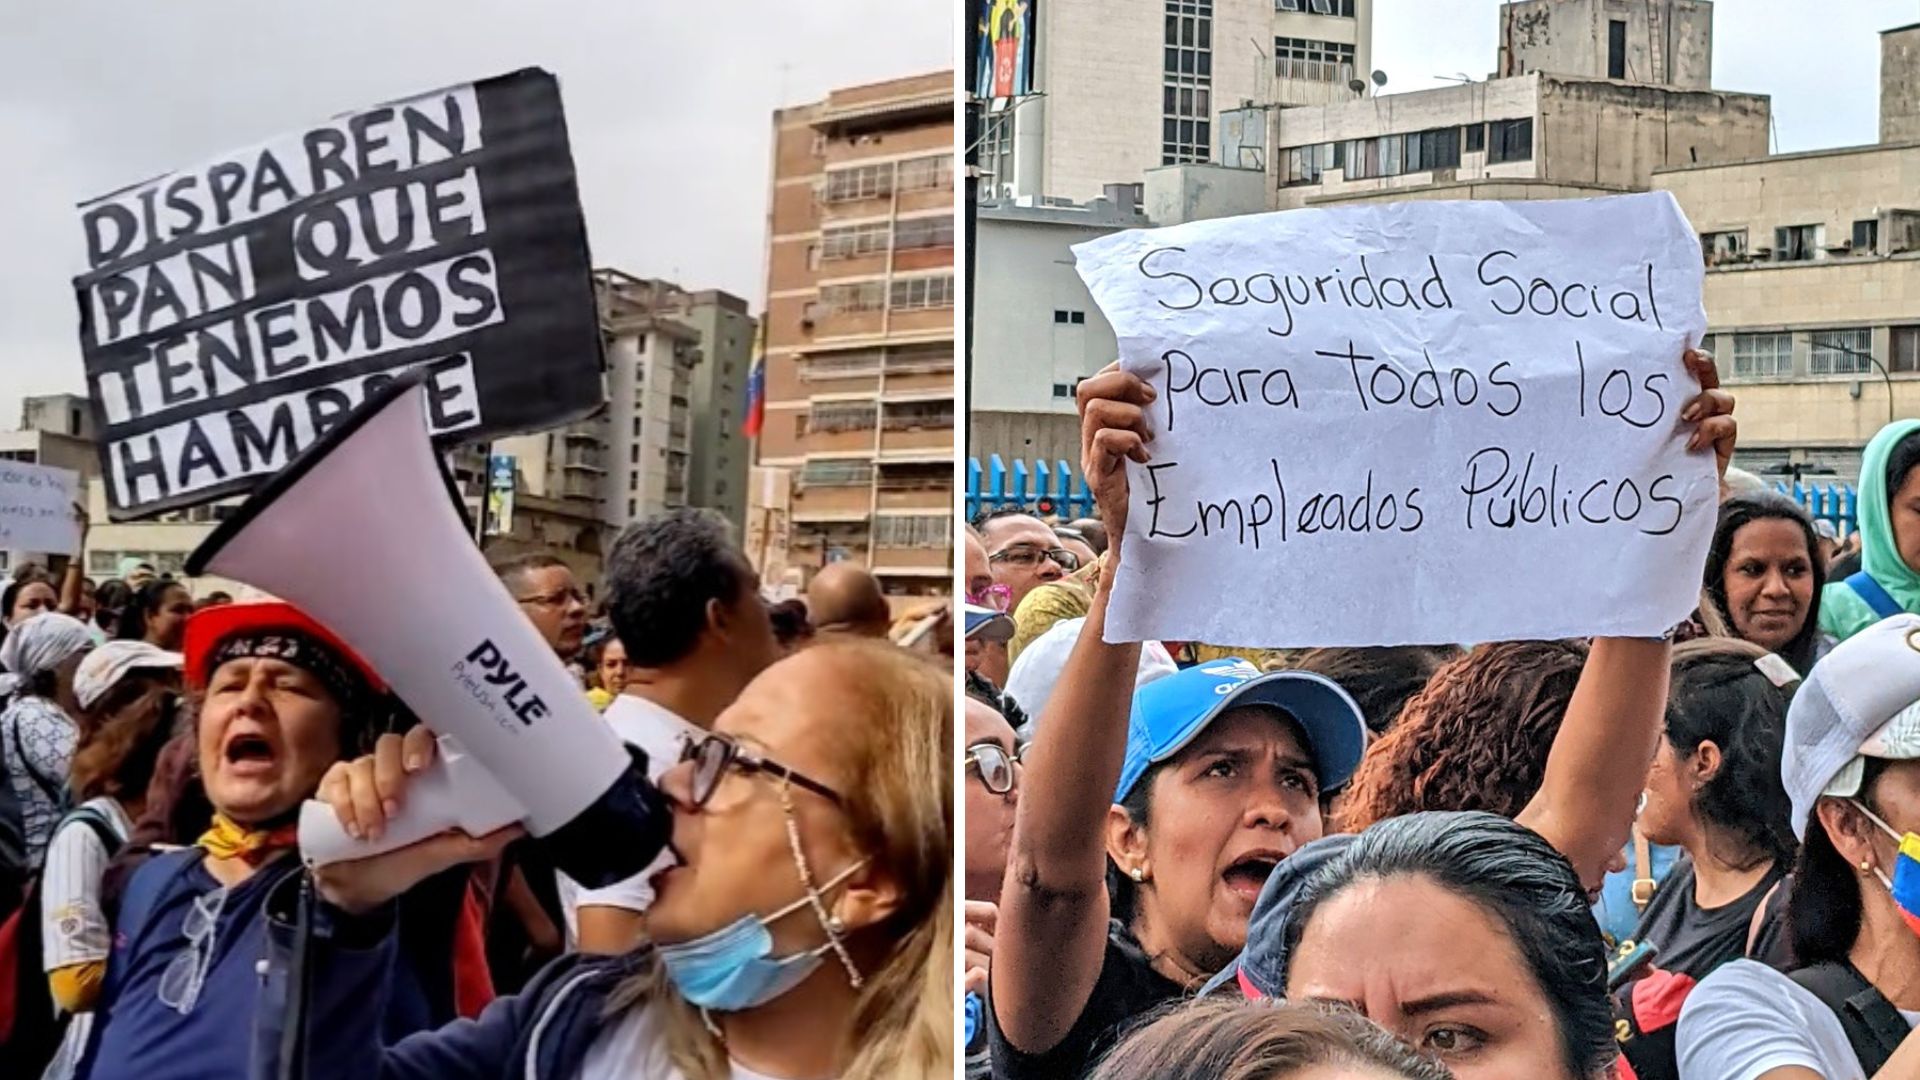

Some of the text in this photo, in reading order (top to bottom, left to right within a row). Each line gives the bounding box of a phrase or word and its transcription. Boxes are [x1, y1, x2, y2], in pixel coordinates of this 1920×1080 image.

[84, 95, 466, 267] DISPAREN
[99, 181, 474, 338] PAN QUE
[1138, 247, 1661, 337] Seguridad Social
[106, 257, 496, 420] TENEMOS
[1315, 339, 1522, 417] todos
[1575, 340, 1668, 428] los
[1146, 446, 1684, 550] Empleados Públicos
[466, 638, 549, 726] PYLE
